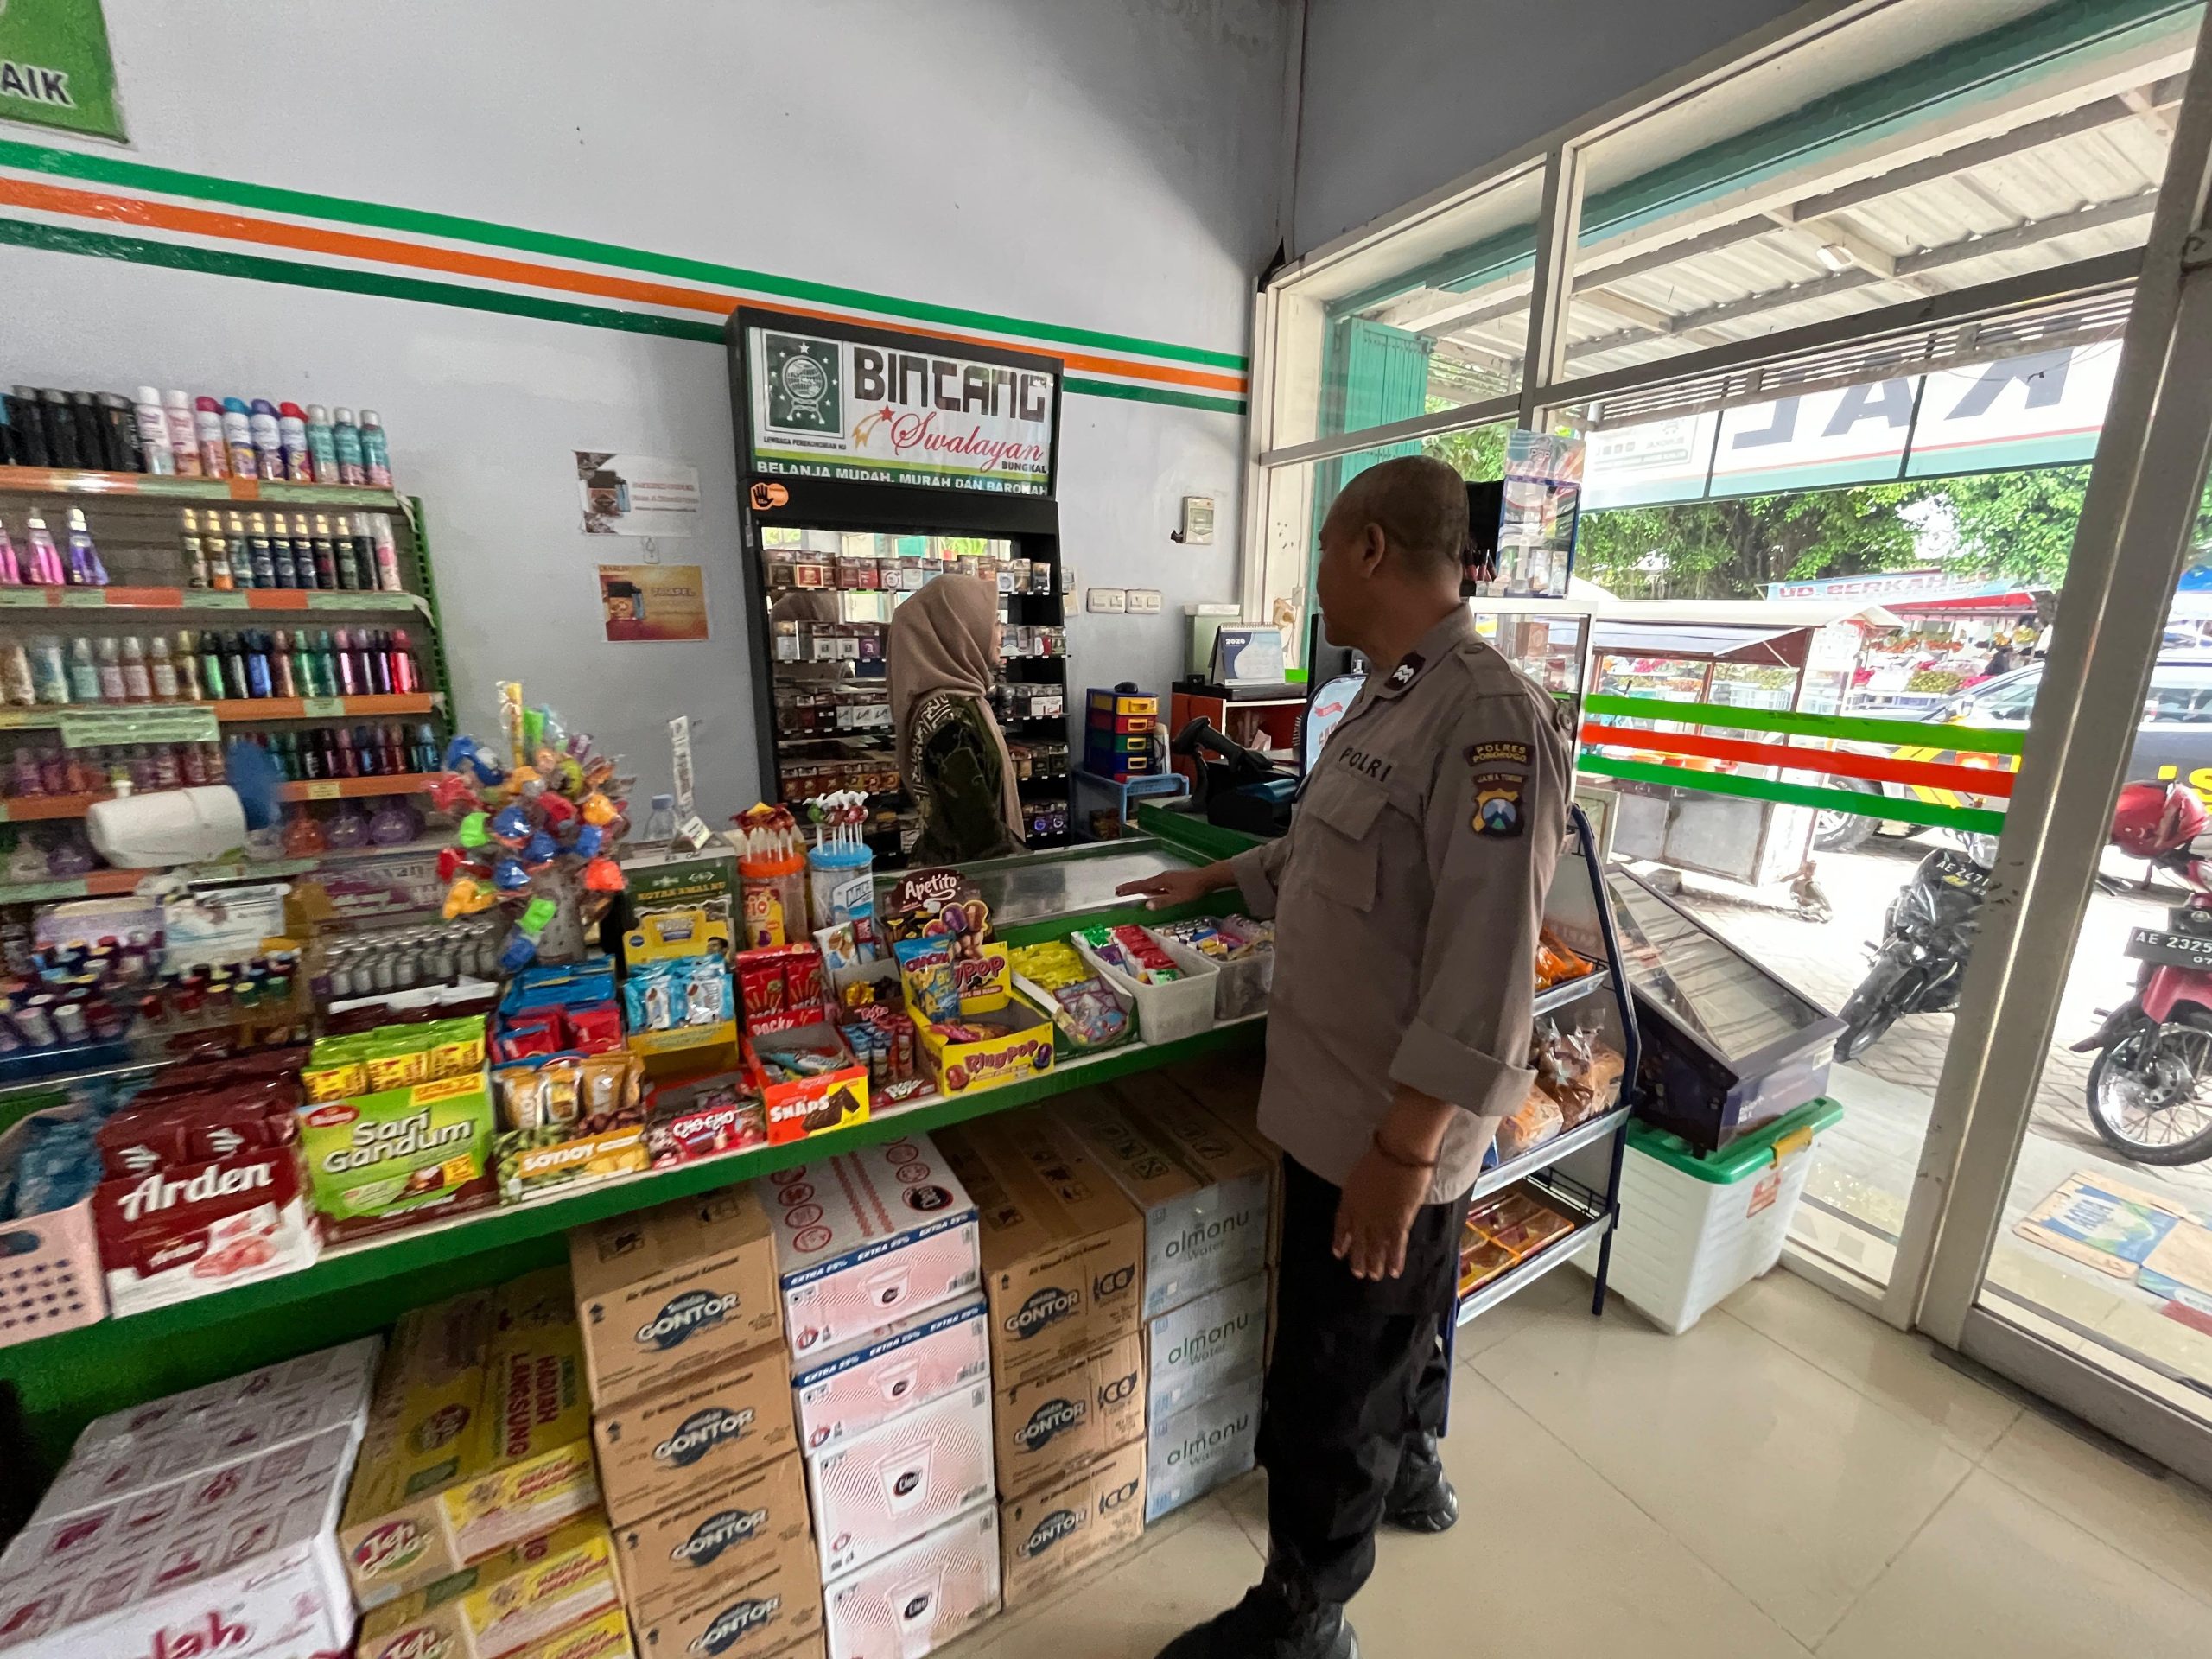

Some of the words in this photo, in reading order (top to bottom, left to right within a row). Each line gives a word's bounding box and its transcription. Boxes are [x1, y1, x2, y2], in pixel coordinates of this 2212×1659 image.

[854, 347, 1047, 423] BINTANG
[890, 411, 1043, 473] Swalayan
[757, 461, 830, 477] BELANJA
[899, 474, 950, 488] MURAH
[956, 478, 982, 491] DAN
[1002, 461, 1046, 474] BUNGKAL
[1339, 747, 1392, 782] POLRI
[1472, 752, 1527, 763] PONOROGO
[1476, 744, 1526, 754] POLRES
[905, 874, 957, 900] Apetito
[1936, 861, 1955, 872] AE
[2136, 932, 2158, 944] AE
[323, 1121, 474, 1173] Gandum
[352, 1106, 431, 1146] Sari
[118, 1164, 274, 1222] Arden
[791, 1268, 823, 1285] EXTRA
[857, 1244, 888, 1261] EXTRA
[919, 1221, 948, 1236] EXTRA
[636, 1293, 740, 1342] GONTOR
[1004, 1290, 1079, 1332] GONTOR
[804, 1365, 836, 1383] EXTRA
[869, 1338, 899, 1357] EXTRA
[930, 1316, 958, 1332] EXTRA
[652, 1408, 754, 1459] GONTOR
[1014, 1400, 1085, 1444] GONTOR
[671, 1508, 768, 1560] GONTOR
